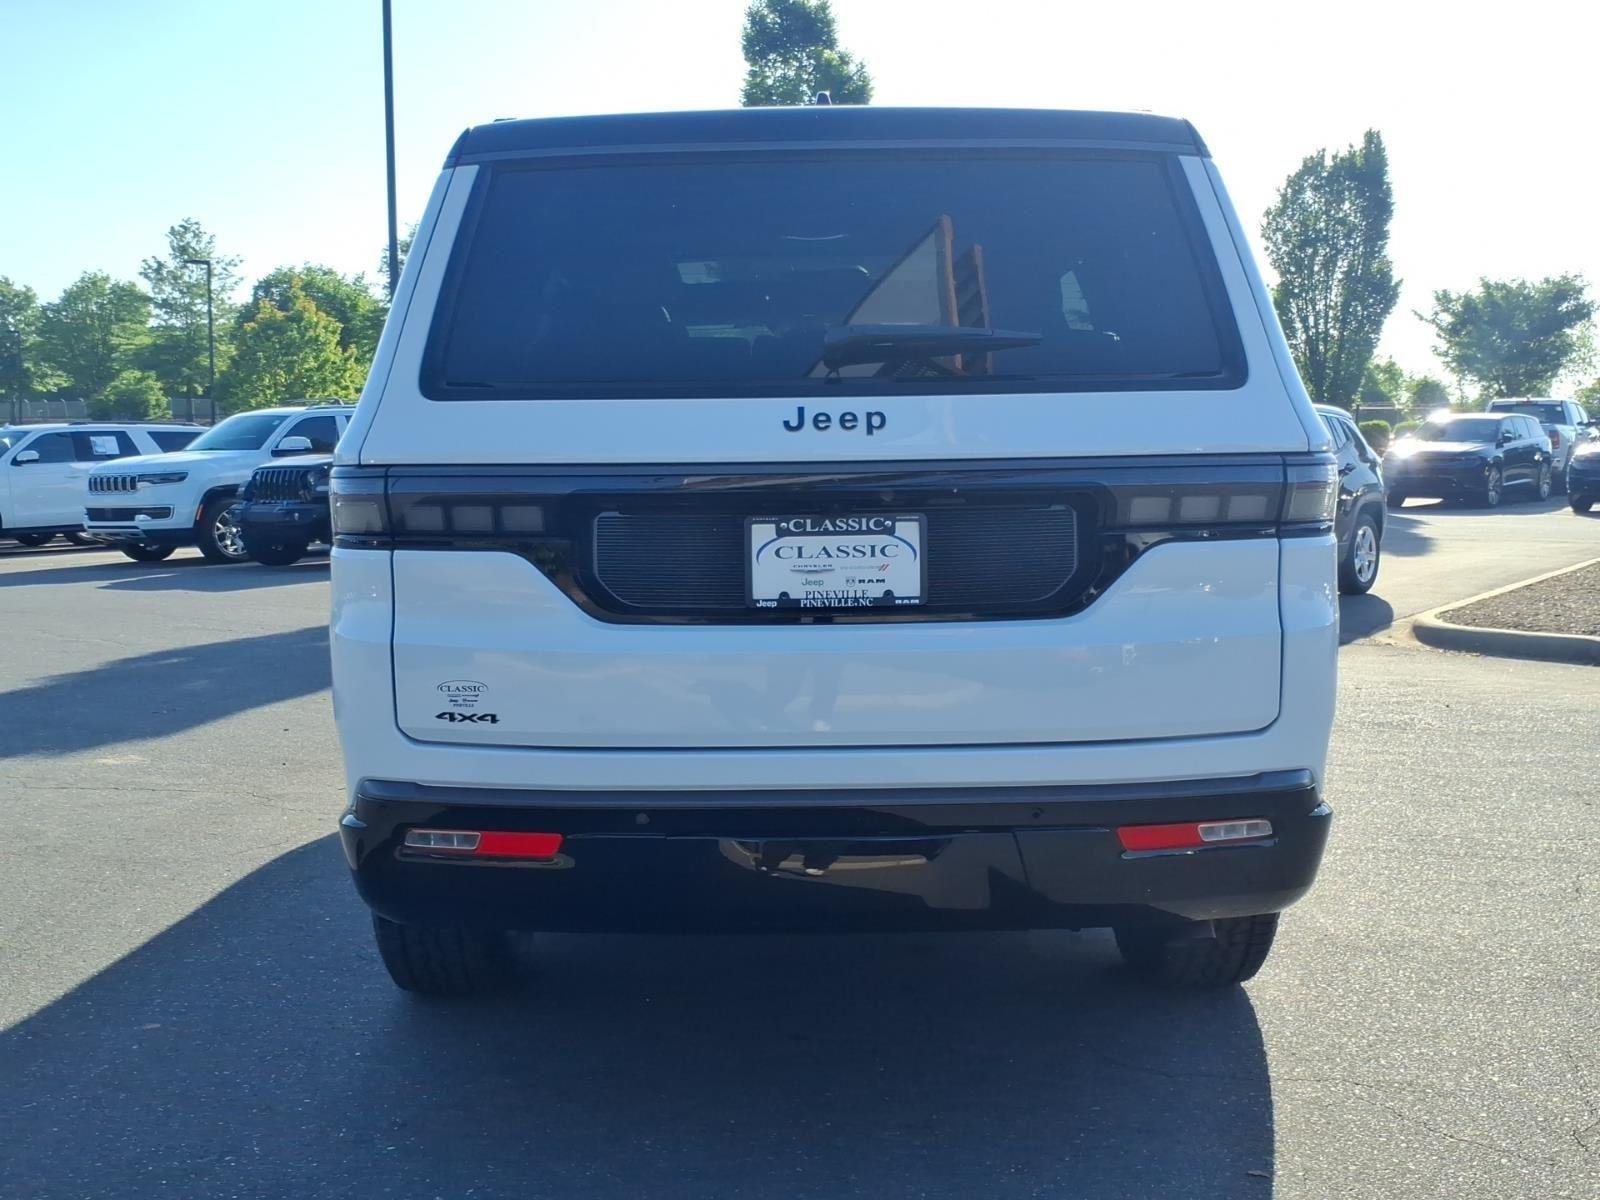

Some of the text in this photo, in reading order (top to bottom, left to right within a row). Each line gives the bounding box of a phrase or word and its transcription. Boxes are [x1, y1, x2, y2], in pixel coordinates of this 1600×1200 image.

[783, 406, 887, 436] Jeep
[788, 517, 885, 533] CLASSIC
[774, 544, 900, 561] CLASSIC
[802, 578, 824, 588] Jeep
[804, 589, 869, 599] PINEVILLE
[756, 599, 778, 608] Jeep
[859, 598, 874, 607] NC
[435, 711, 500, 724] 4x4
